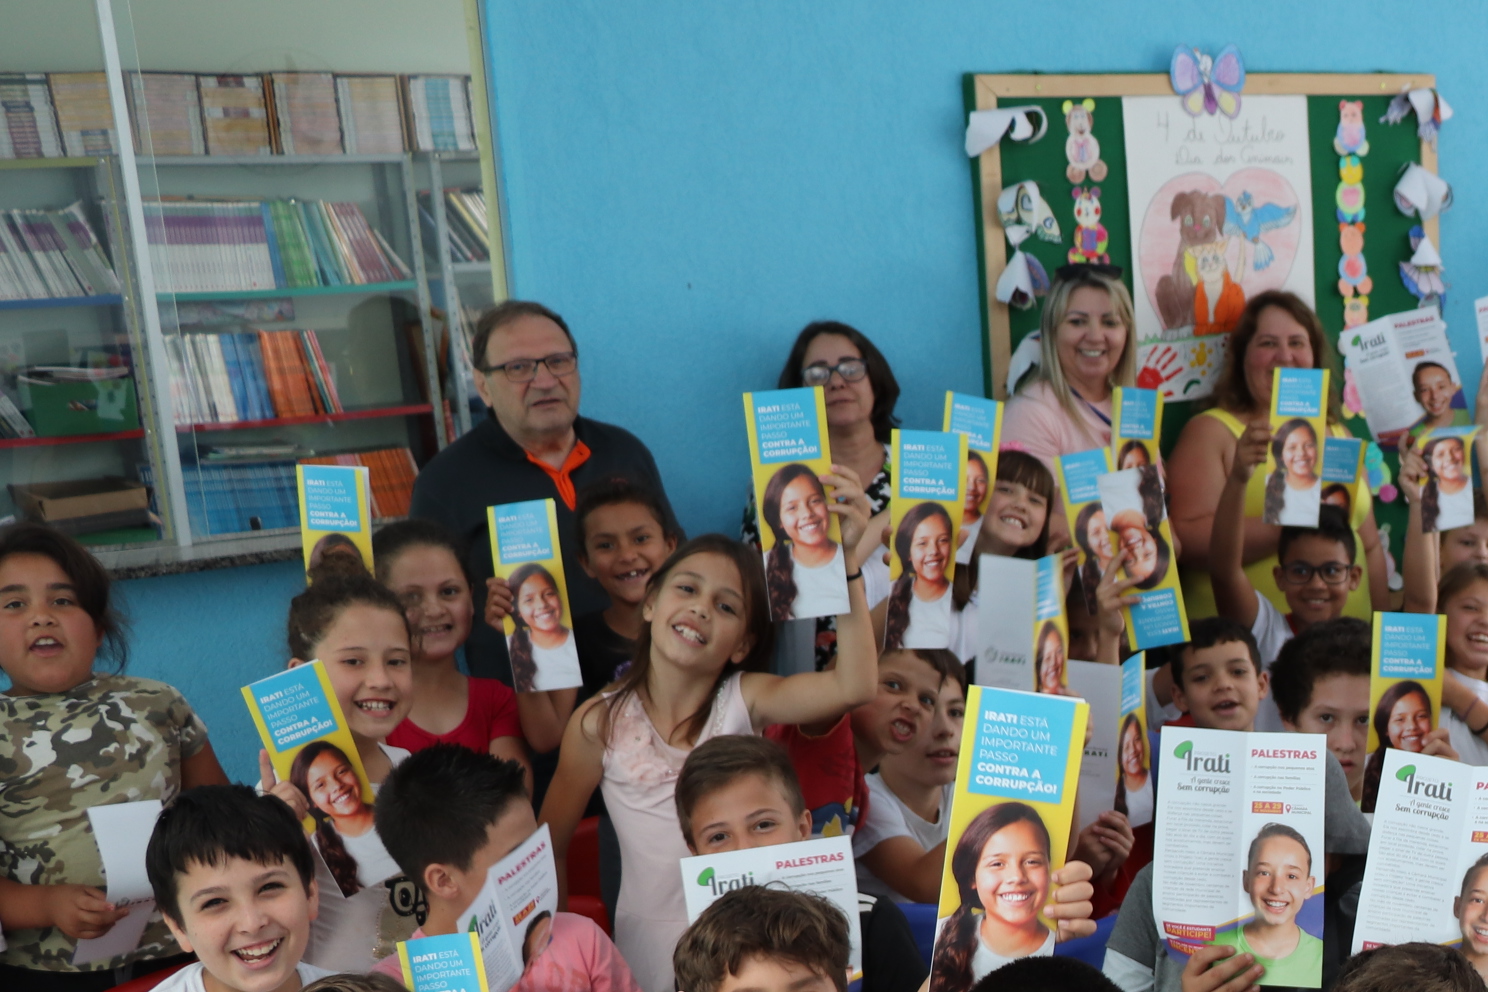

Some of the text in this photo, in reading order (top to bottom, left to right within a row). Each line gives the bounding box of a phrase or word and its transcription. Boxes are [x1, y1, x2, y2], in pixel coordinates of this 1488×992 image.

[1157, 111, 1169, 142] 4
[1184, 115, 1205, 142] de
[1175, 145, 1203, 165] Dia
[1213, 146, 1236, 165] dos
[757, 405, 779, 413] IRATI
[762, 439, 796, 448] CONTRA
[763, 445, 817, 457] CORRUPÇÃO!
[259, 683, 304, 704] IRATI ESTÁ
[263, 690, 310, 712] DANDO UM
[267, 696, 318, 719] IMPORTANTE
[270, 714, 298, 728] PASSO
[274, 719, 310, 736] CONTRA
[984, 710, 1048, 728] IRATI ESTÁ
[277, 719, 332, 744] CORRUPÇÃO!
[982, 723, 1050, 741] DANDO UM
[981, 736, 1057, 755] IMPORTANTE
[1252, 749, 1317, 759] PALESTRAS
[979, 748, 1018, 763] PASSO
[1183, 750, 1230, 774] Irati
[977, 762, 1041, 779] CONTRA A
[975, 774, 1057, 793] CORRUPÇÃO!
[1404, 773, 1452, 801] Irati
[498, 841, 546, 885] PALESTRAS
[776, 852, 844, 869] PALESTRAS
[412, 949, 459, 963] IRATI ESTÁ
[415, 959, 463, 972] DANDO UM
[417, 967, 472, 981] IMPORTANTE
[418, 980, 448, 990] PASSO
